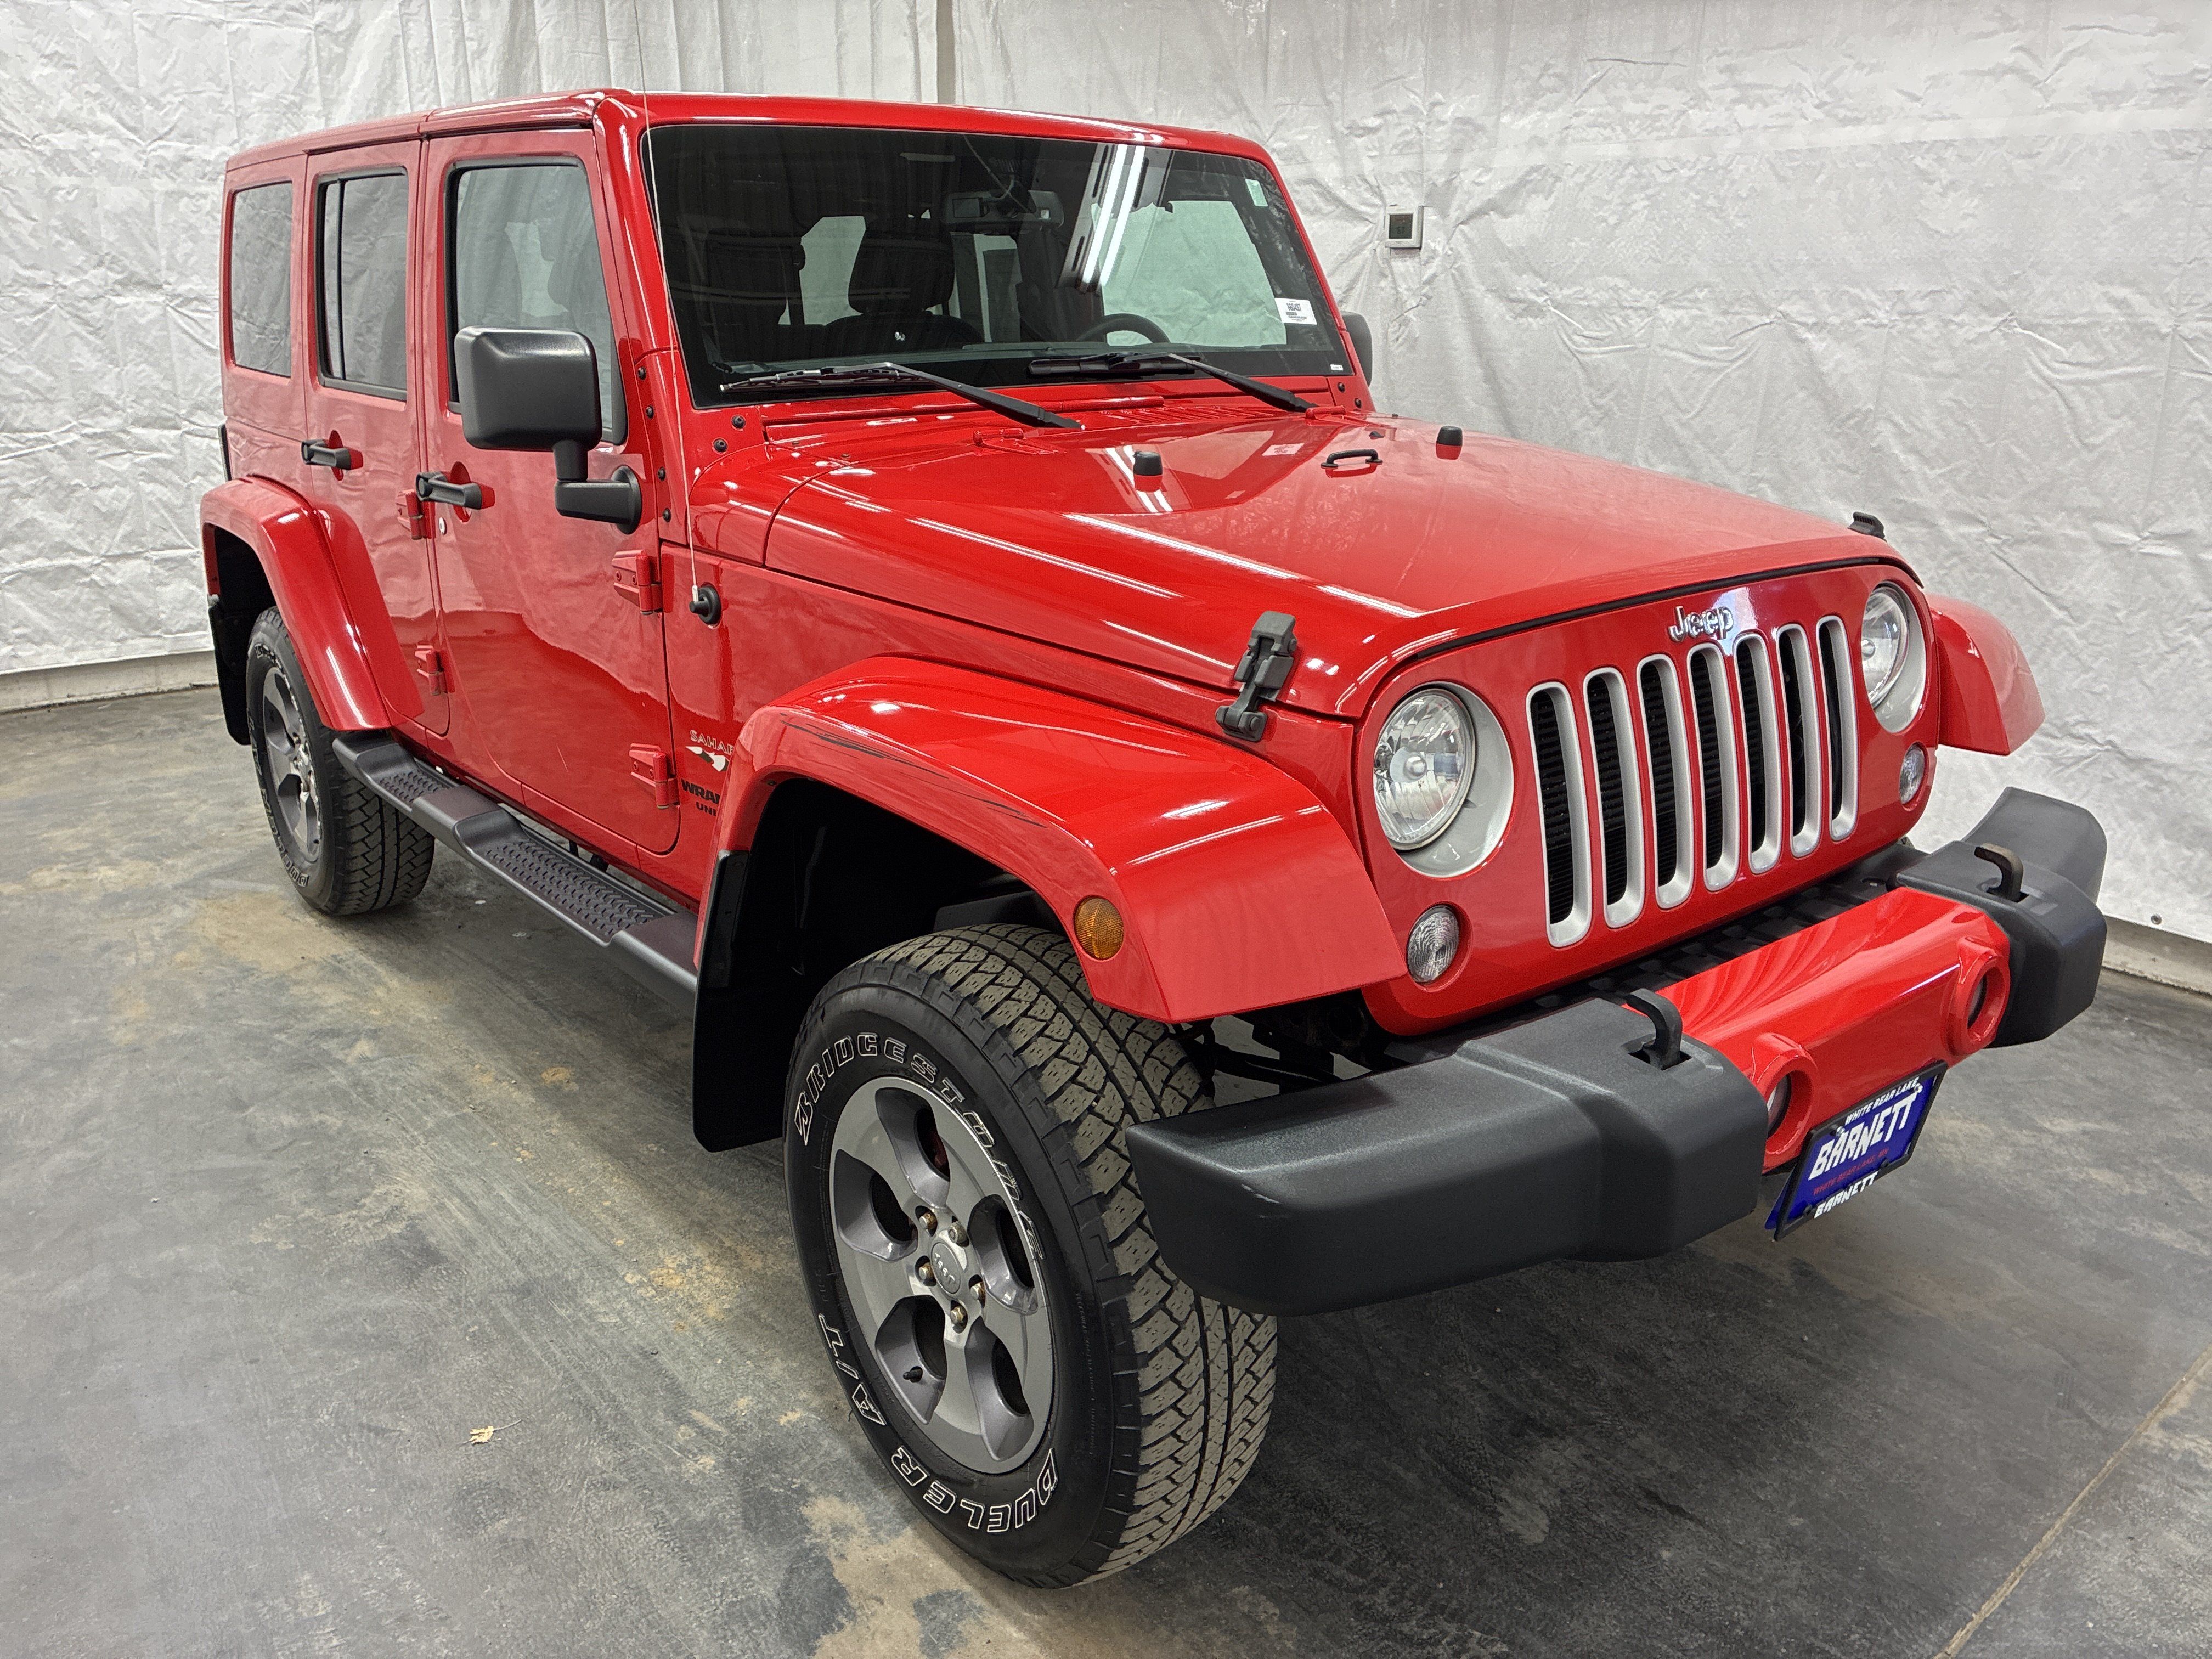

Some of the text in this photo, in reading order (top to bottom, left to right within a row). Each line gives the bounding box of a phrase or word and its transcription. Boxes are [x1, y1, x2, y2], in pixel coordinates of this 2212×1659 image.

[1668, 605, 1734, 642] Jeep
[1808, 1093, 1919, 1181] BARNETT
[1844, 1102, 1874, 1126] WHITE
[1872, 1089, 1897, 1110] BEAR
[794, 1032, 1043, 1260] BRIDGESTONE
[1814, 1171, 1878, 1220] BARNETT
[891, 1447, 1058, 1533] DUELER
